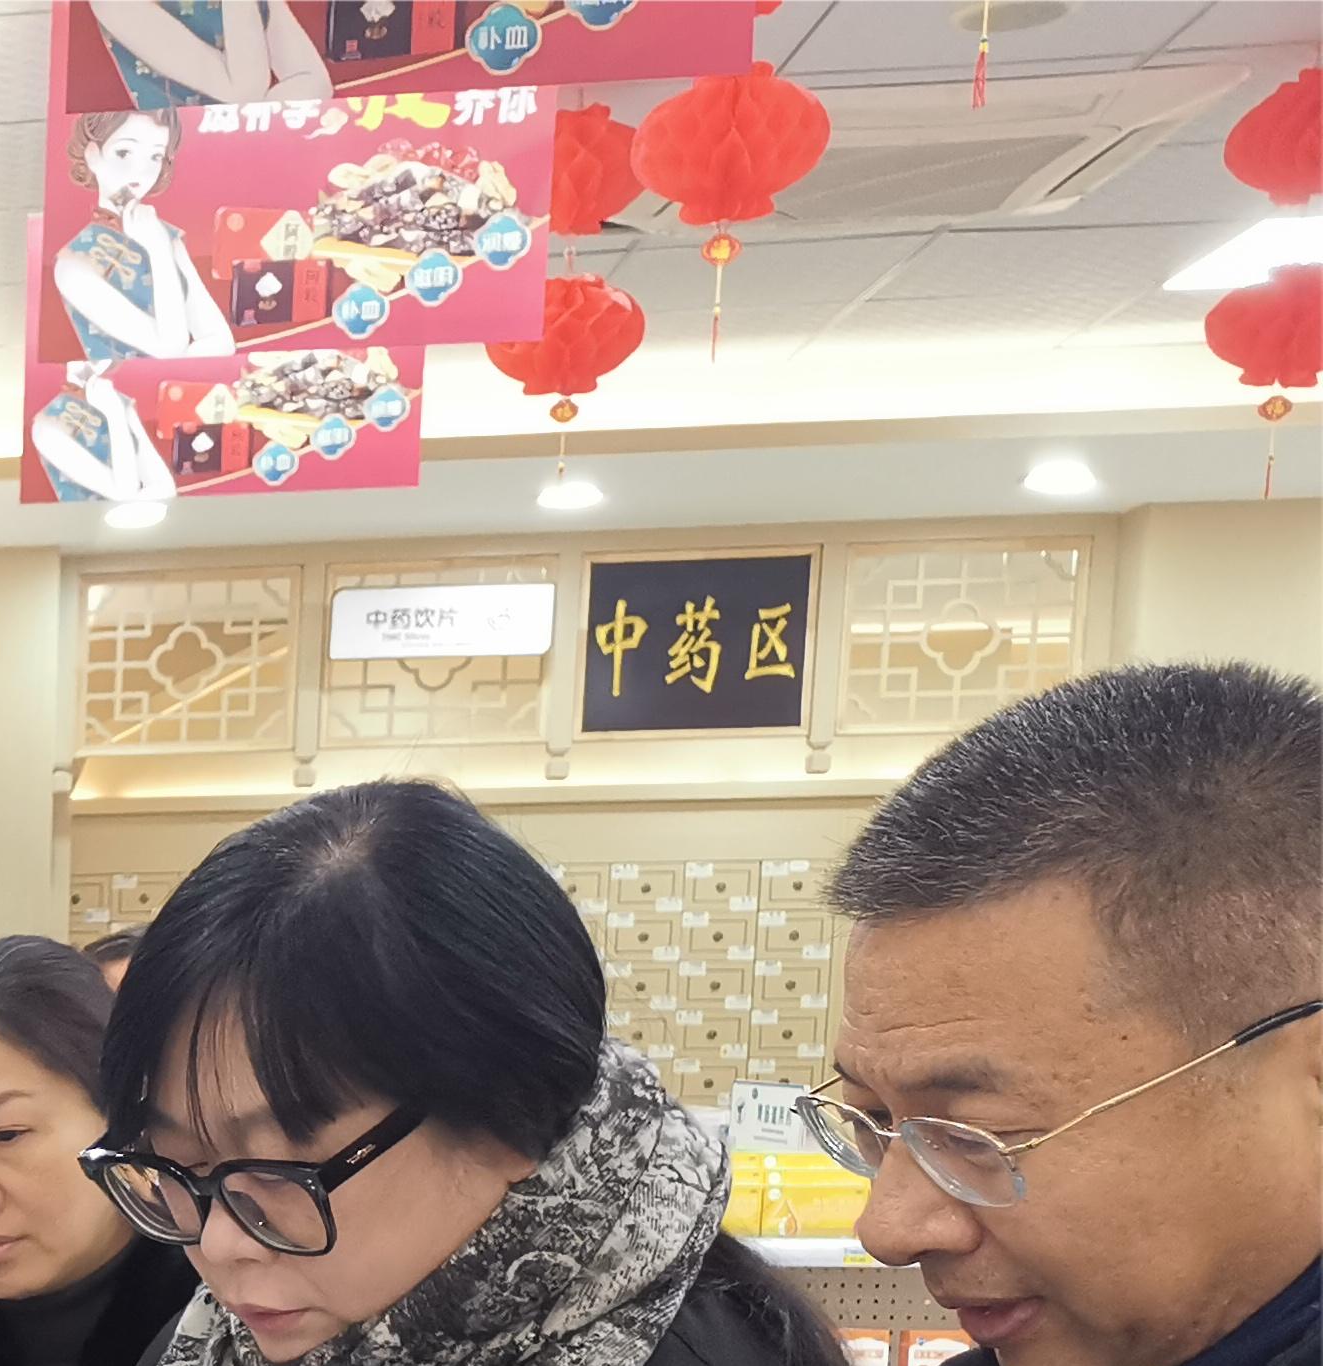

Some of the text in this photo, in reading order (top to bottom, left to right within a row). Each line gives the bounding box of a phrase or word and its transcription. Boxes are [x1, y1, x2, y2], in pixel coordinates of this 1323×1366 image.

[366, 608, 457, 630] 中药饮片
[595, 596, 796, 698] 中药区
